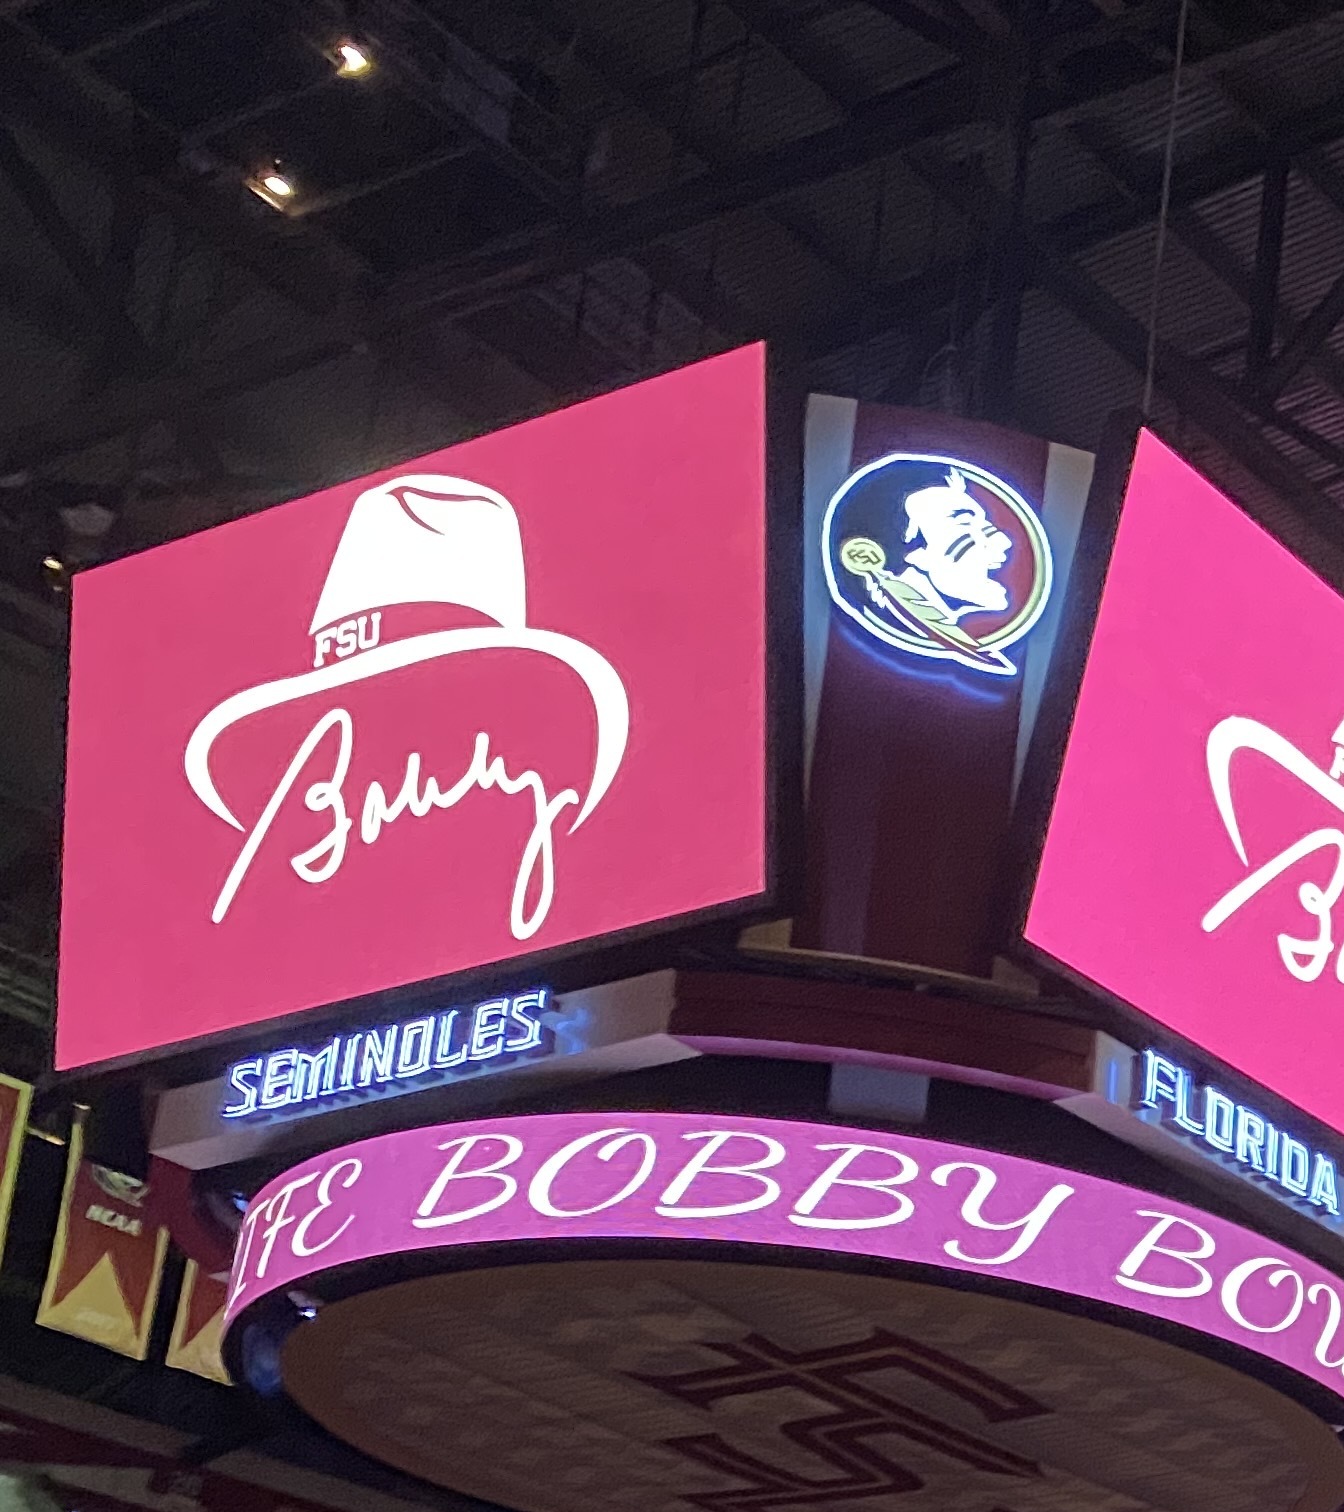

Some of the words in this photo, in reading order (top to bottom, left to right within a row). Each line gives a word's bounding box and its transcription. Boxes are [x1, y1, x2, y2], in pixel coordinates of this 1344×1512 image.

[313, 612, 381, 668] FSU
[223, 989, 547, 1118] SEMINOLES
[1140, 1048, 1341, 1217] FLORIDA
[224, 1158, 362, 1320] IFE
[413, 1127, 1074, 1265] BOBBY
